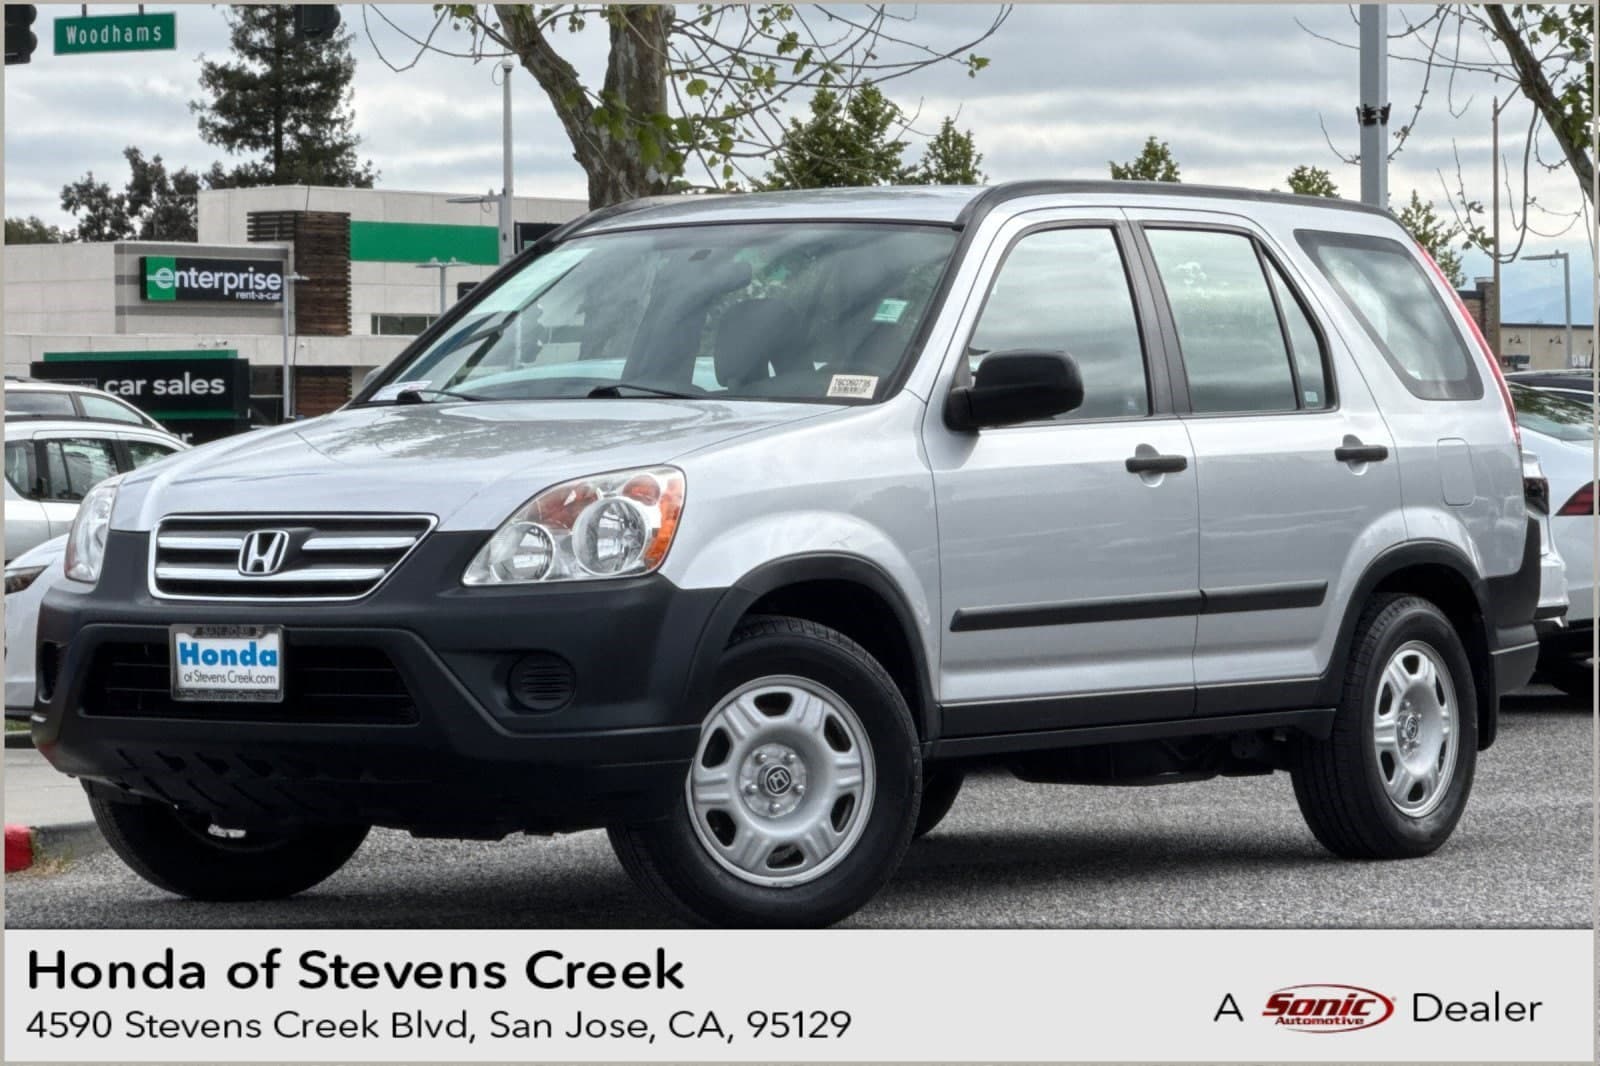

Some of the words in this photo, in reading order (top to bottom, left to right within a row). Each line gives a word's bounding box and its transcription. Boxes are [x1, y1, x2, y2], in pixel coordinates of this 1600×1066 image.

[65, 24, 162, 45] Woodhams
[153, 266, 282, 296] enterprise
[235, 290, 281, 300] rent-a-car
[103, 378, 148, 396] car
[152, 371, 226, 396] sales
[179, 641, 278, 667] Honda
[183, 670, 193, 683] of
[194, 669, 226, 683] Stevens
[227, 669, 277, 685] Creek.com
